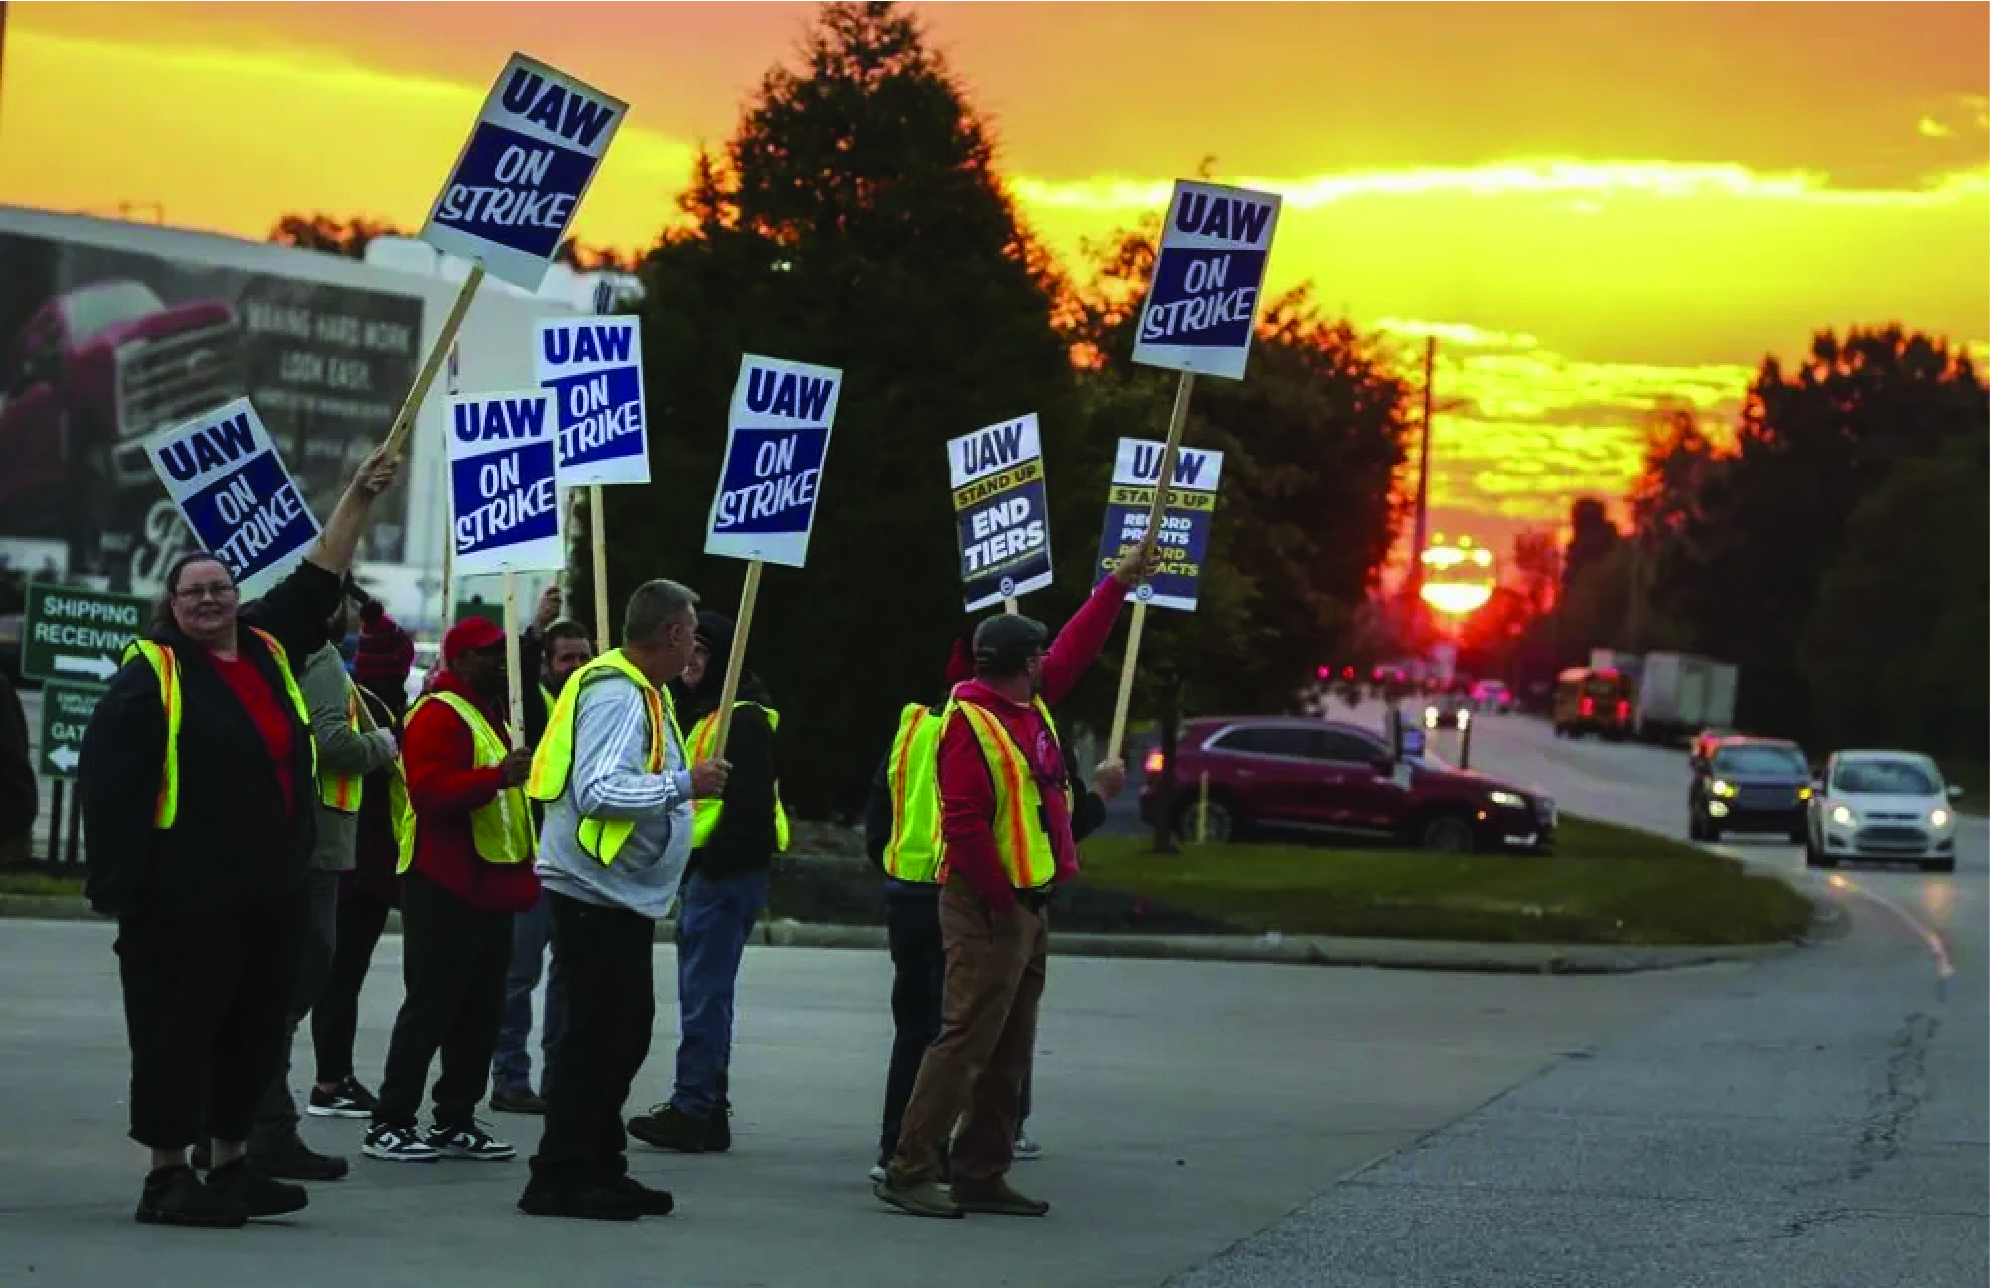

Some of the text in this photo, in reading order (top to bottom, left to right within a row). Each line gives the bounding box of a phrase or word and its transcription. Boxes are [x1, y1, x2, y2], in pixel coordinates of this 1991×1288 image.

[503, 67, 614, 148] UAW
[494, 144, 555, 187] ON
[438, 183, 577, 229] STRIKE
[1176, 191, 1272, 244] UAW
[1183, 254, 1231, 294] ON
[1143, 286, 1256, 340] STRIKE
[543, 326, 632, 365] UAW
[570, 374, 610, 417] ON
[747, 367, 834, 421] UAW
[453, 398, 547, 442] UAW
[559, 399, 641, 462] TRIKE
[158, 412, 257, 481] UAW
[755, 432, 799, 477] ON
[963, 422, 1023, 475] UAW
[479, 451, 520, 498] ON
[715, 467, 821, 528] STRIKE
[958, 463, 1037, 506] STAND UP
[1116, 488, 1209, 506] STAD UP
[214, 472, 258, 525] ON
[456, 475, 556, 551] STRIKE
[972, 497, 1030, 541] END
[964, 519, 1046, 572] TIERS
[43, 595, 138, 625] SHIPPING
[50, 721, 87, 743] GAT
